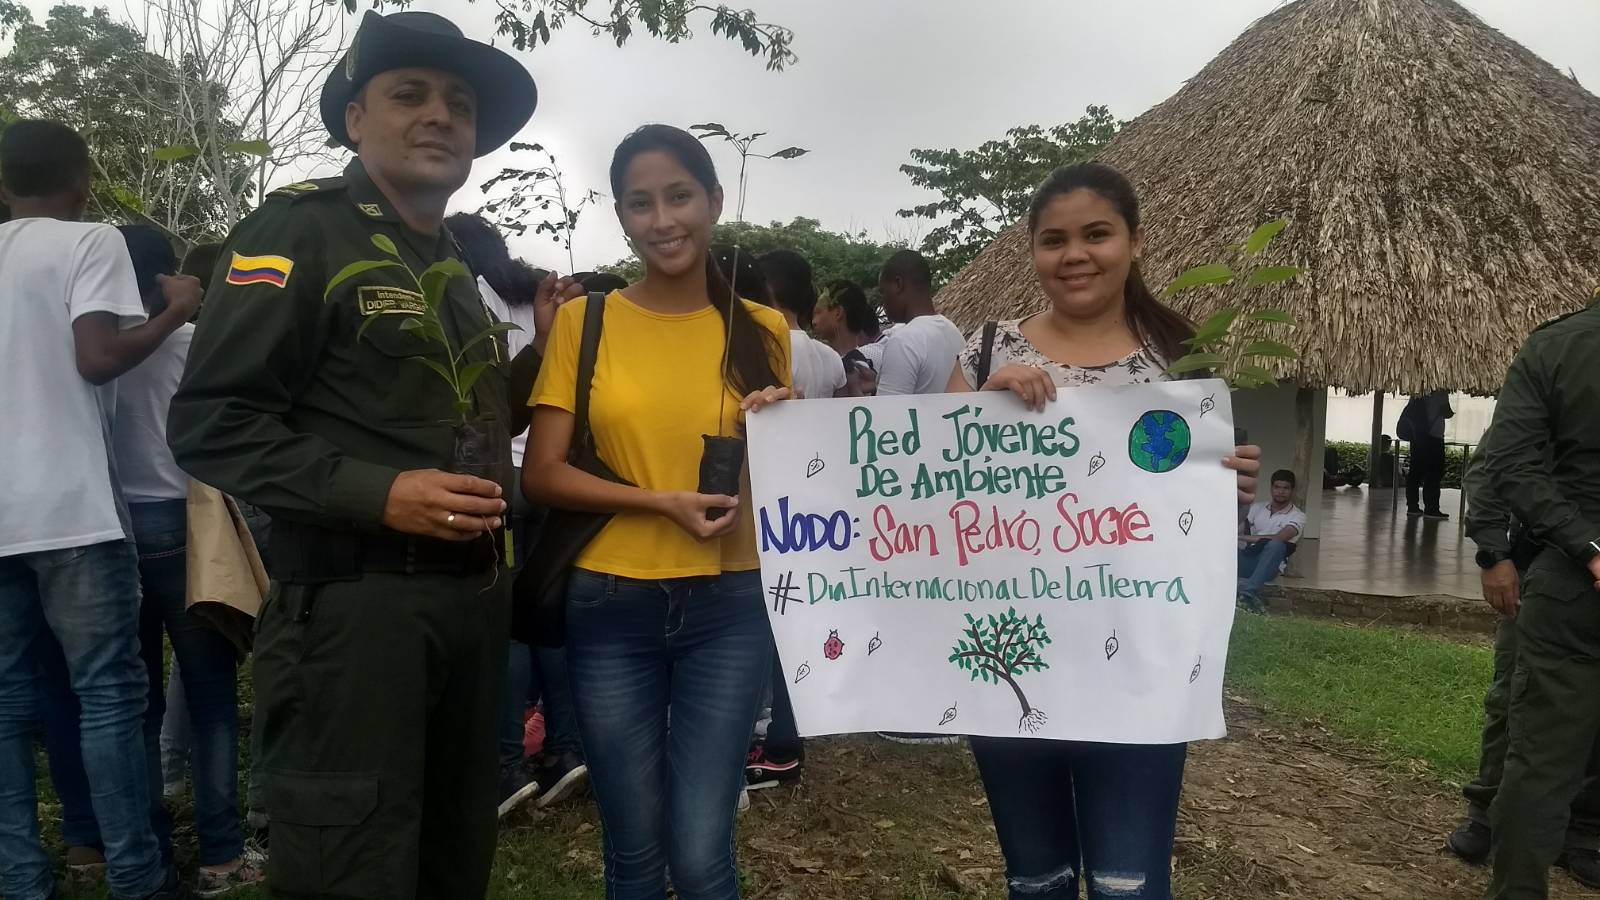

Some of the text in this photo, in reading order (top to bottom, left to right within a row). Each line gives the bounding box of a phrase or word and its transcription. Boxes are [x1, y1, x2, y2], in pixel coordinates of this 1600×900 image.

[849, 404, 1081, 465] Red Jóvenes
[856, 457, 1068, 500] De Ambiente
[868, 504, 940, 562] San
[1053, 493, 1154, 553] Sucre
